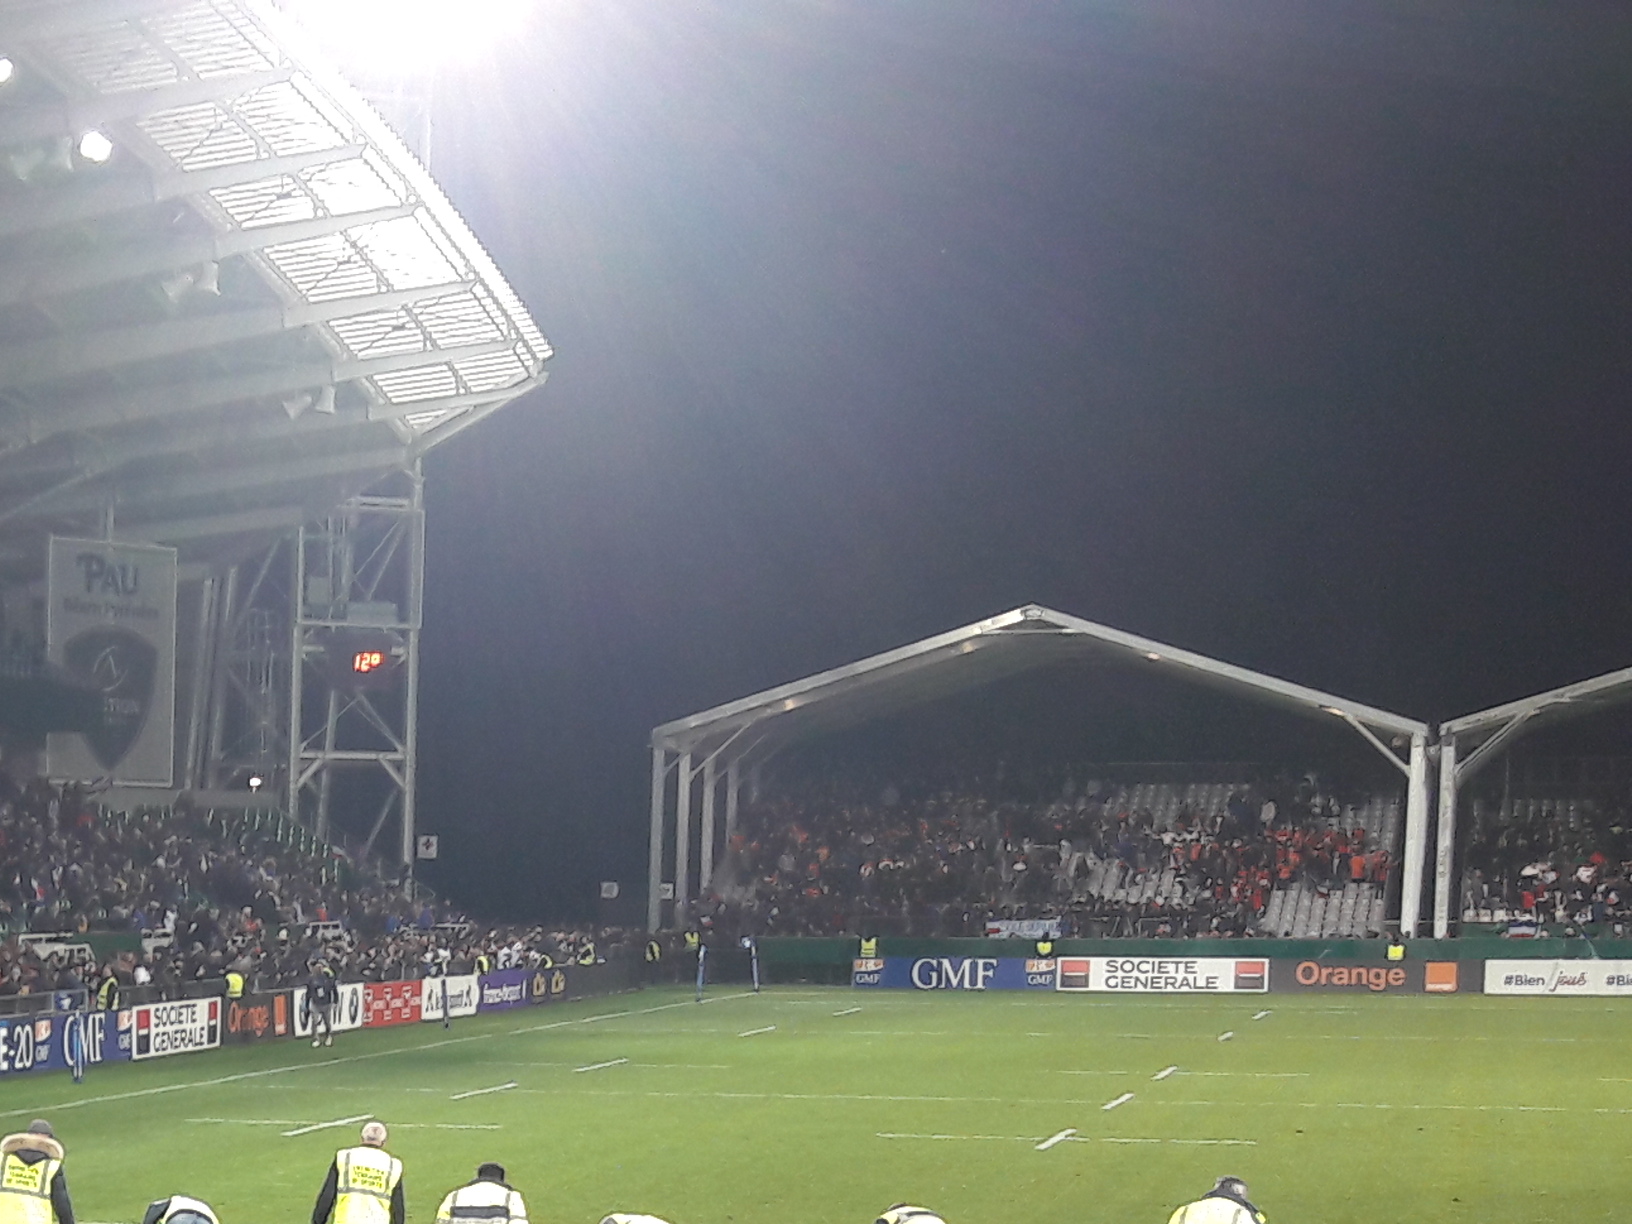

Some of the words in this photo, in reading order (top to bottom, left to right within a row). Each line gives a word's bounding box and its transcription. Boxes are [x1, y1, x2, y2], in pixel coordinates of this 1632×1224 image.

[911, 957, 998, 990] GMF
[1104, 959, 1198, 975] SOCIETE
[1295, 961, 1407, 991] Orange
[1104, 975, 1220, 990] GENERALE
[153, 1003, 198, 1028] SOCIETE
[153, 1026, 205, 1053] GENERALE
